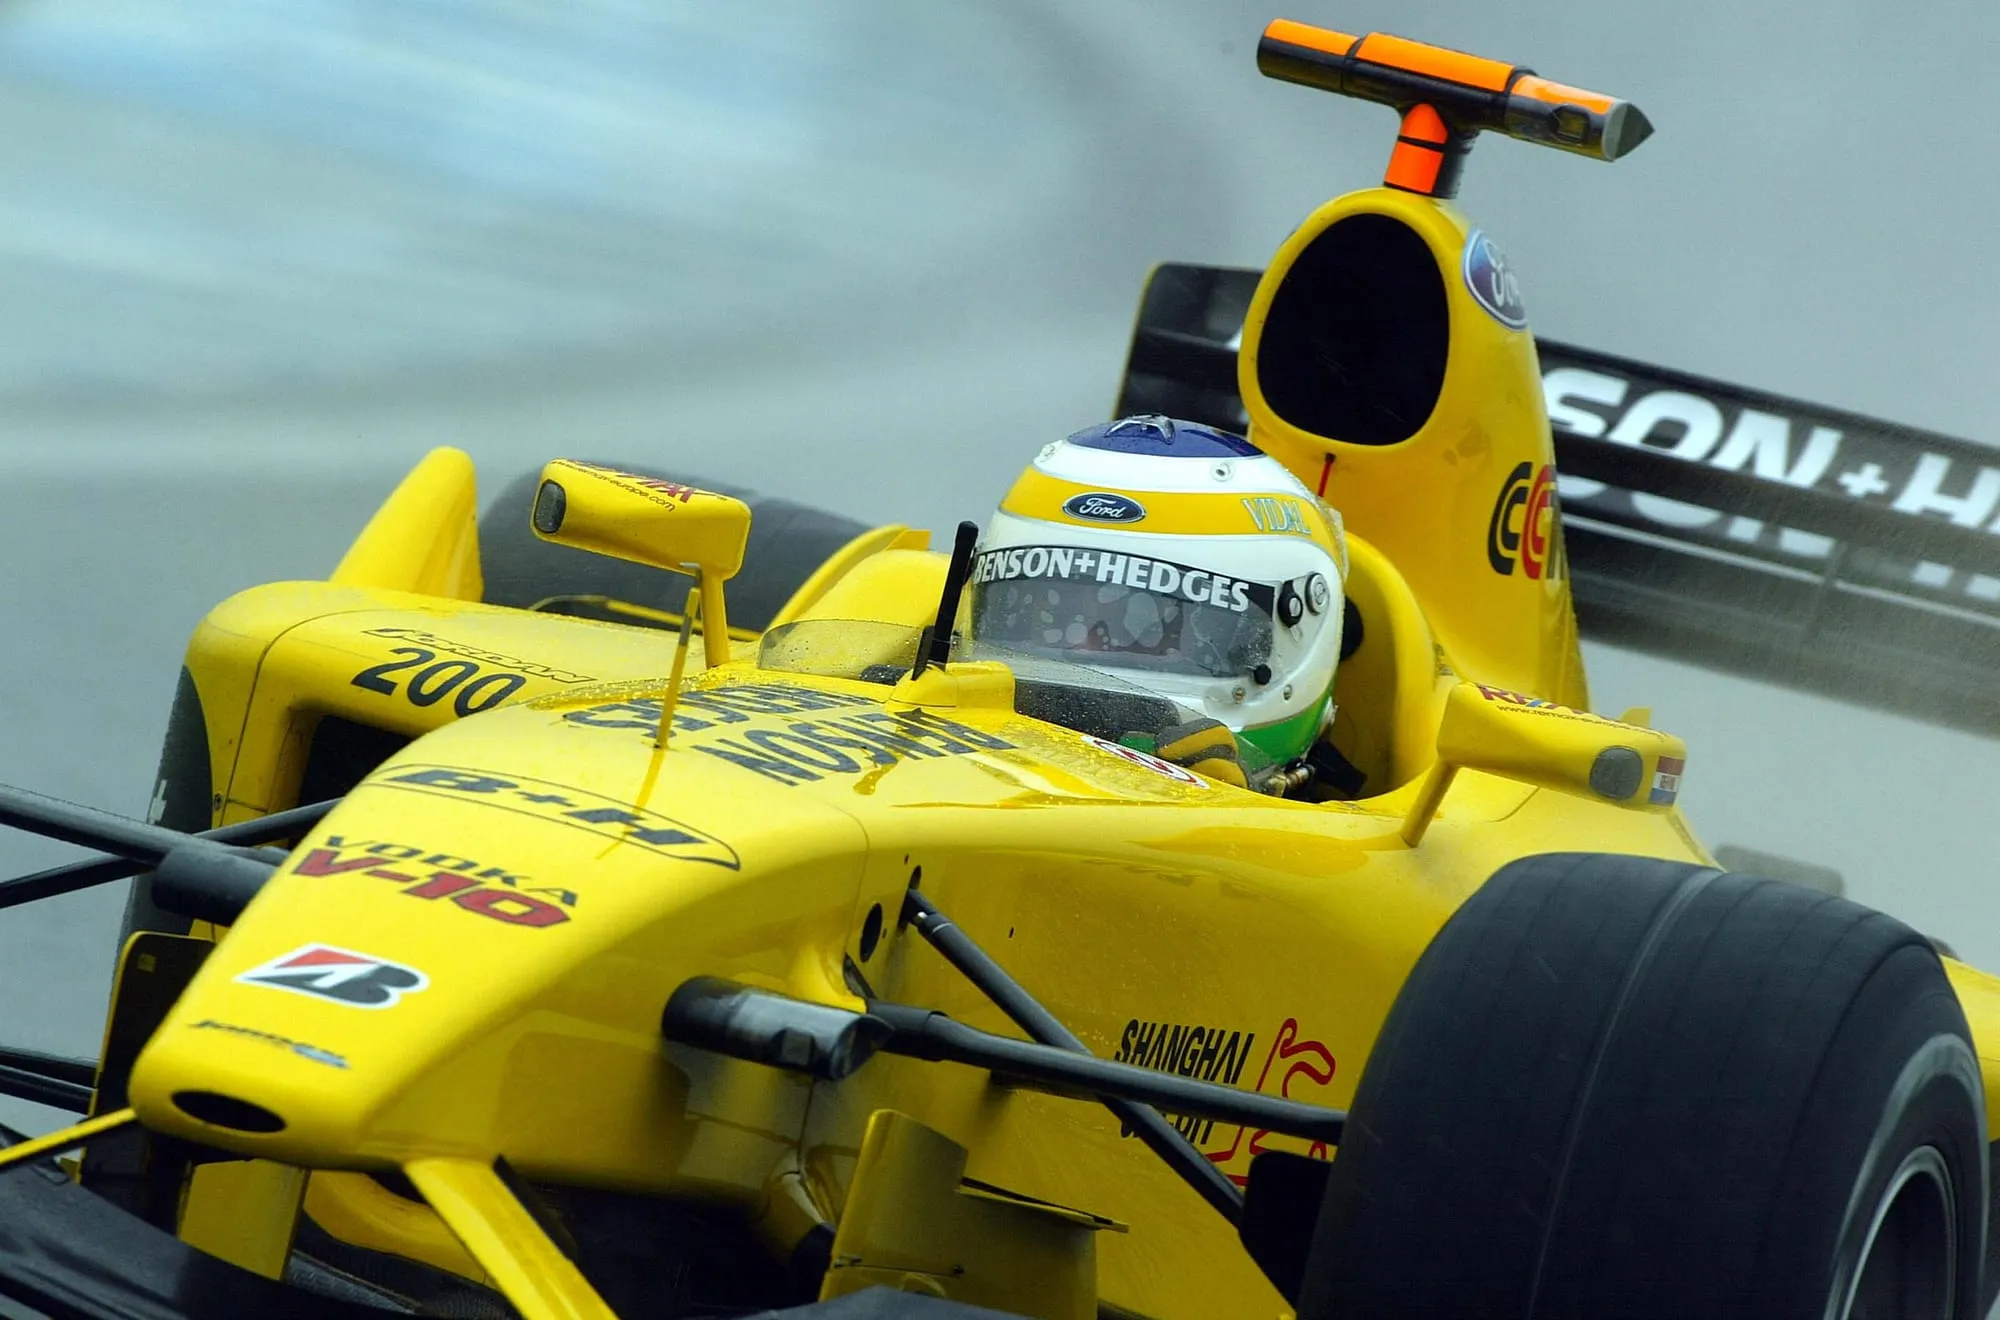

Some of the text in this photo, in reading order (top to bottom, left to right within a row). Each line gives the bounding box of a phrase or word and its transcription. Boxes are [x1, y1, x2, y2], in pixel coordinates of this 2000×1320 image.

[1079, 497, 1127, 519] Ford
[974, 547, 1250, 612] BENSON+HEDGES
[350, 647, 527, 718] 200
[562, 684, 874, 739] HEDGES
[690, 708, 1019, 787] BENSON
[384, 769, 709, 845] B+H
[292, 848, 571, 928] V-10
[325, 835, 578, 908] VODKA
[1115, 1018, 1255, 1085] SHANGHAI
